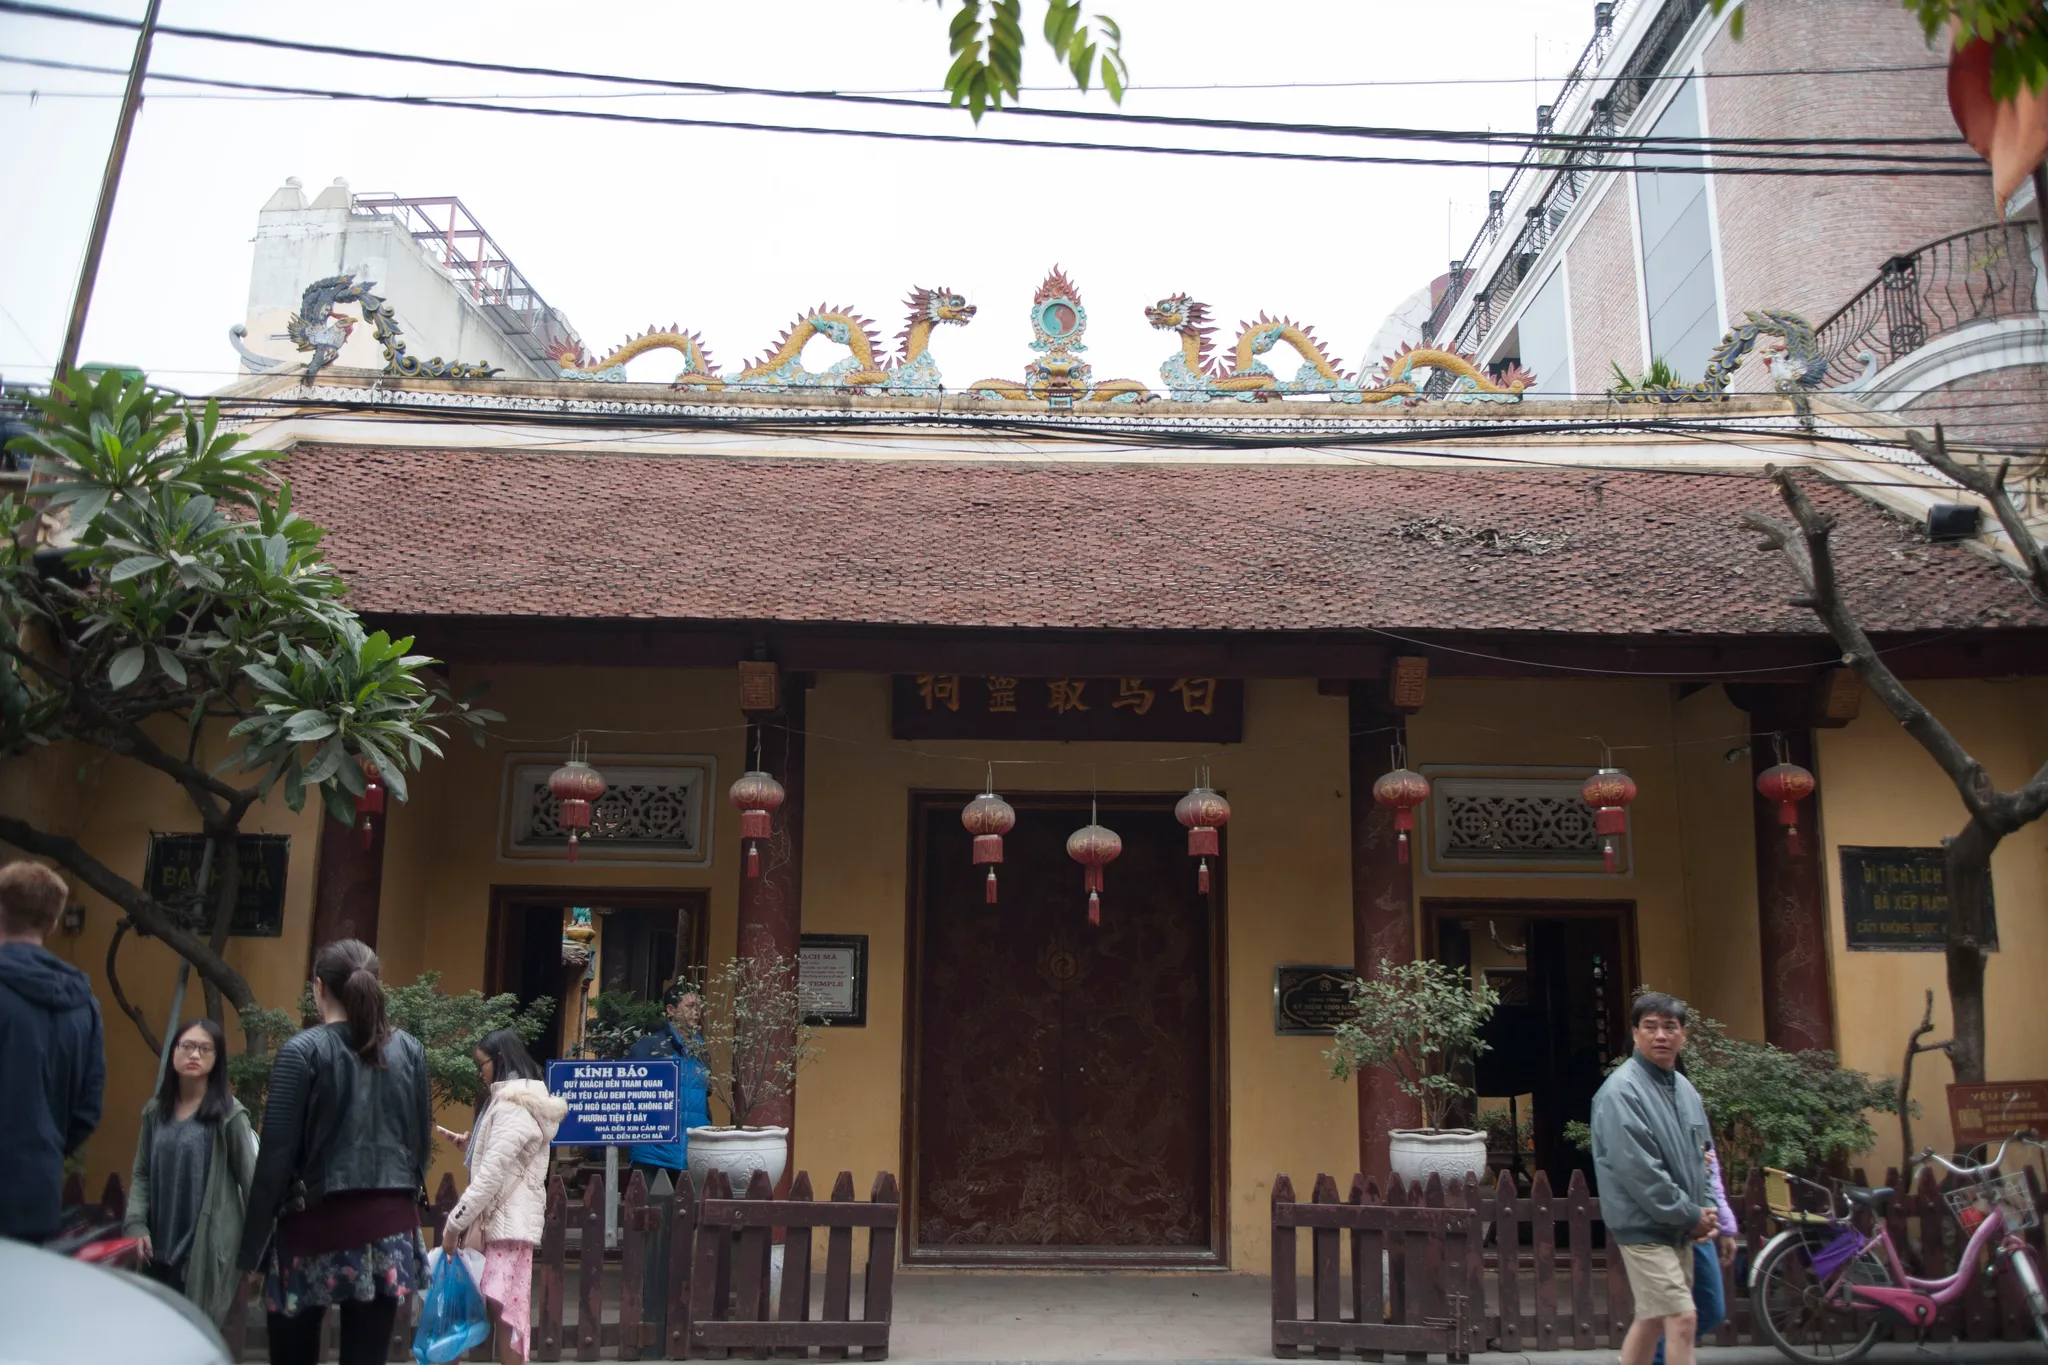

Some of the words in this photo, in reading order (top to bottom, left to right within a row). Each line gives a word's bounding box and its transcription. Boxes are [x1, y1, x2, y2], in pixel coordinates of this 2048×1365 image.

[574, 1065, 613, 1078] KÍNH
[616, 1064, 648, 1078] BÁO
[579, 1079, 604, 1088] KHÁCH
[621, 1079, 641, 1088] THAM
[643, 1079, 663, 1089] QUAN
[578, 1090, 592, 1099] YÊU
[601, 1102, 621, 1112] GẠCH
[638, 1101, 662, 1110] KHÔNG
